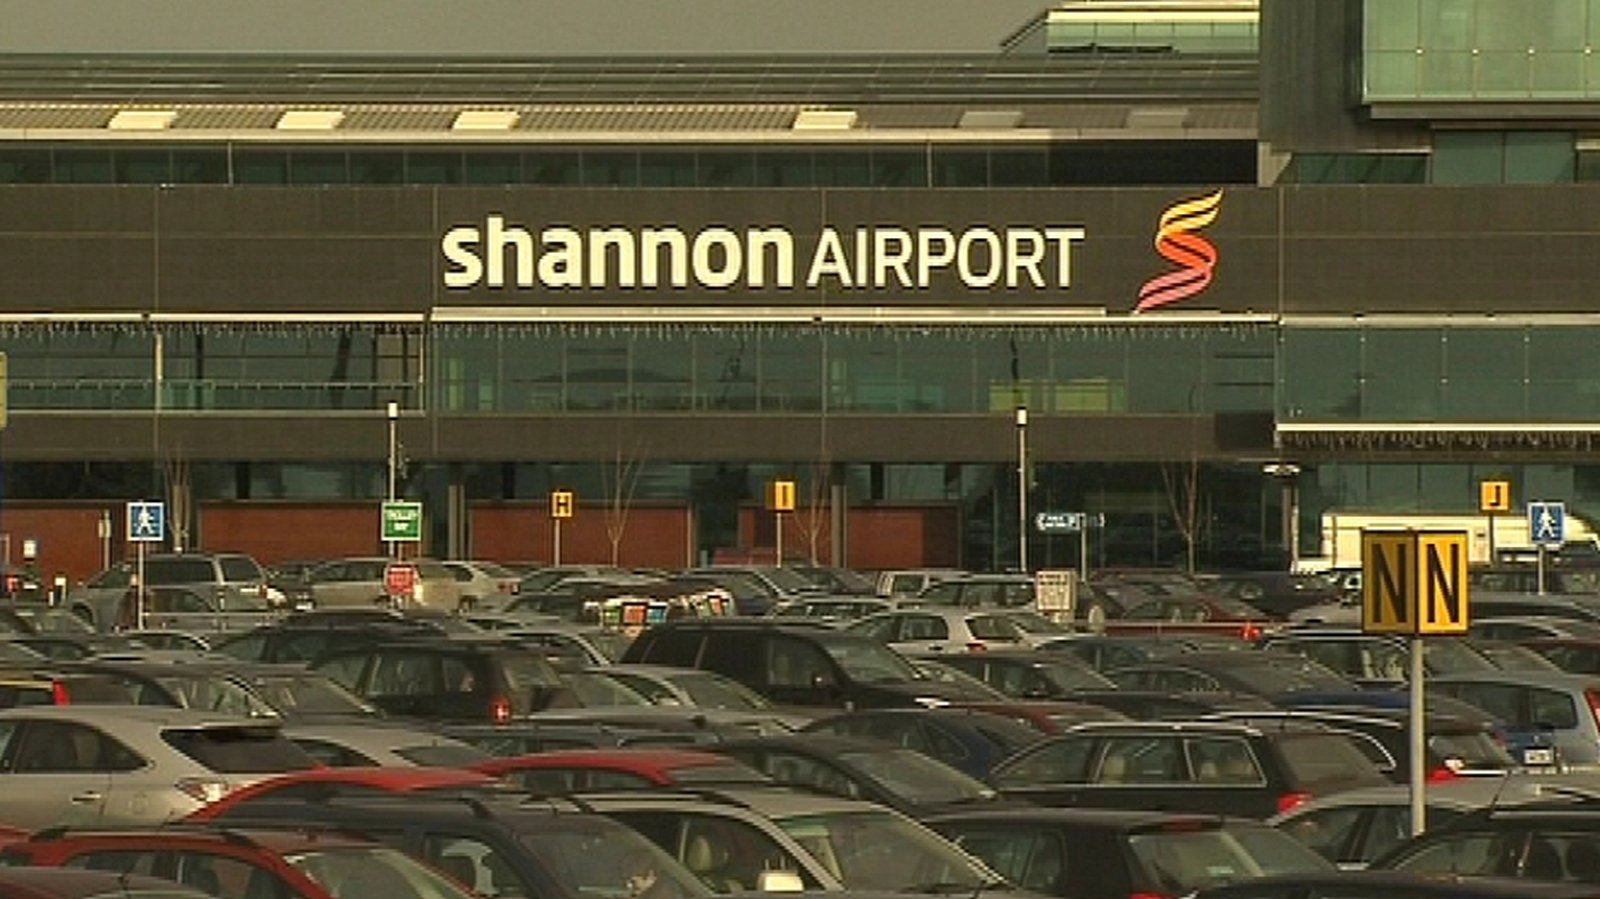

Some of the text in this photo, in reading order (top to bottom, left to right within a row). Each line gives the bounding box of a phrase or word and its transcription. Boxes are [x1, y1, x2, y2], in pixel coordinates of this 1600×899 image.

[442, 216, 1085, 287] shannon AIRPORT
[557, 495, 569, 513] H
[1490, 485, 1501, 506] J
[1371, 543, 1407, 624] N
[1427, 543, 1459, 624] N
